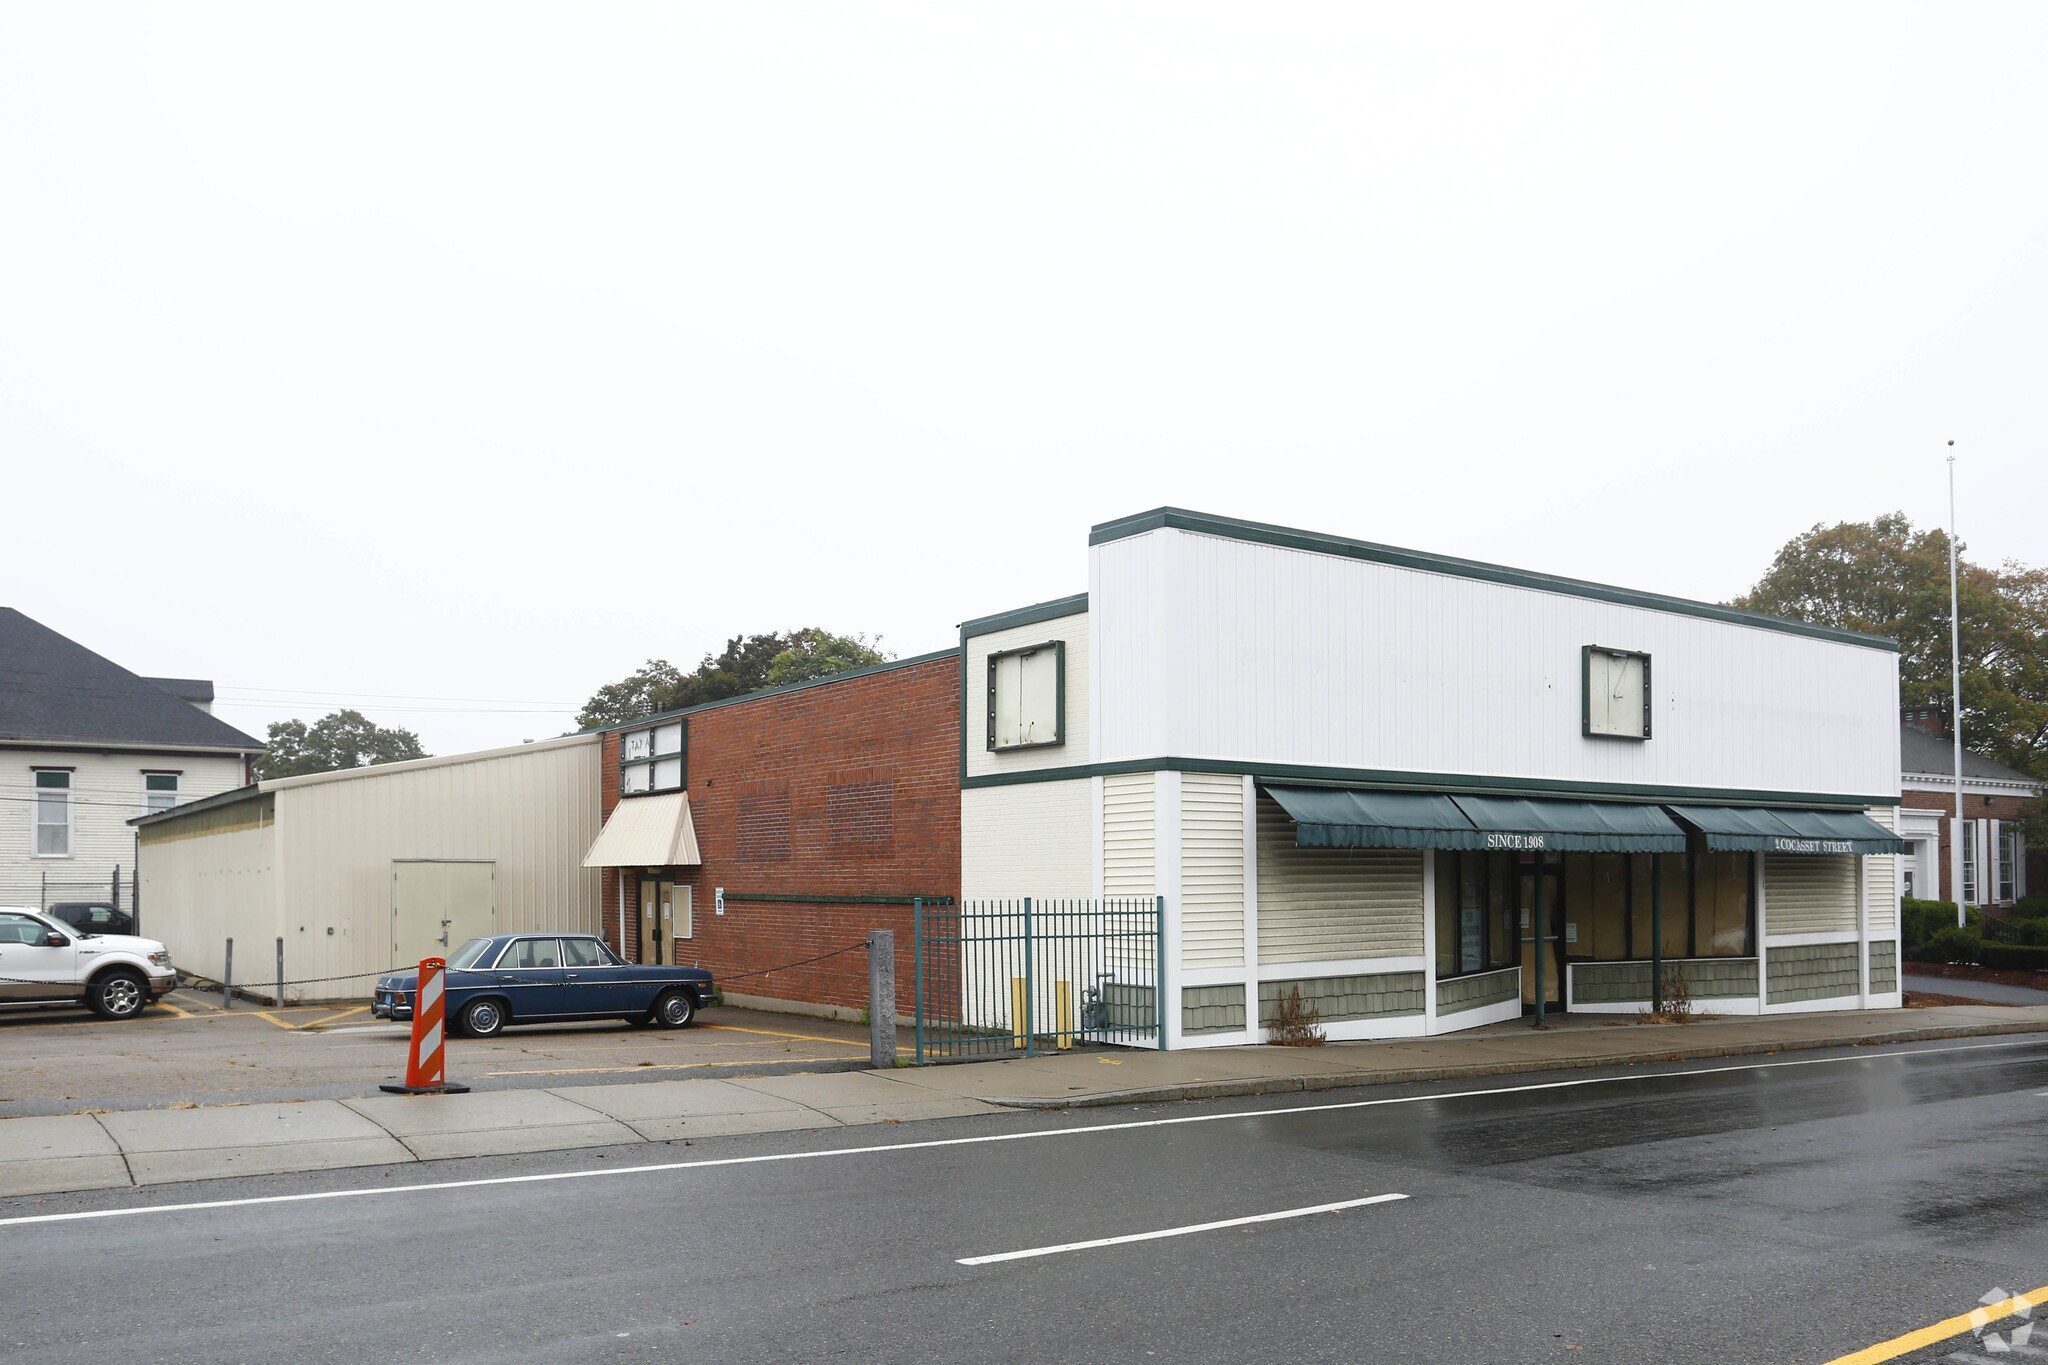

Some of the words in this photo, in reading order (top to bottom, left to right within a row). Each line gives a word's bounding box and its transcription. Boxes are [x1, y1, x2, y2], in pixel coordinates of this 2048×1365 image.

[1487, 834, 1522, 849] SINCE
[1524, 835, 1544, 849] 1908
[1780, 838, 1820, 852] COCASSET
[1822, 841, 1853, 853] STREET
